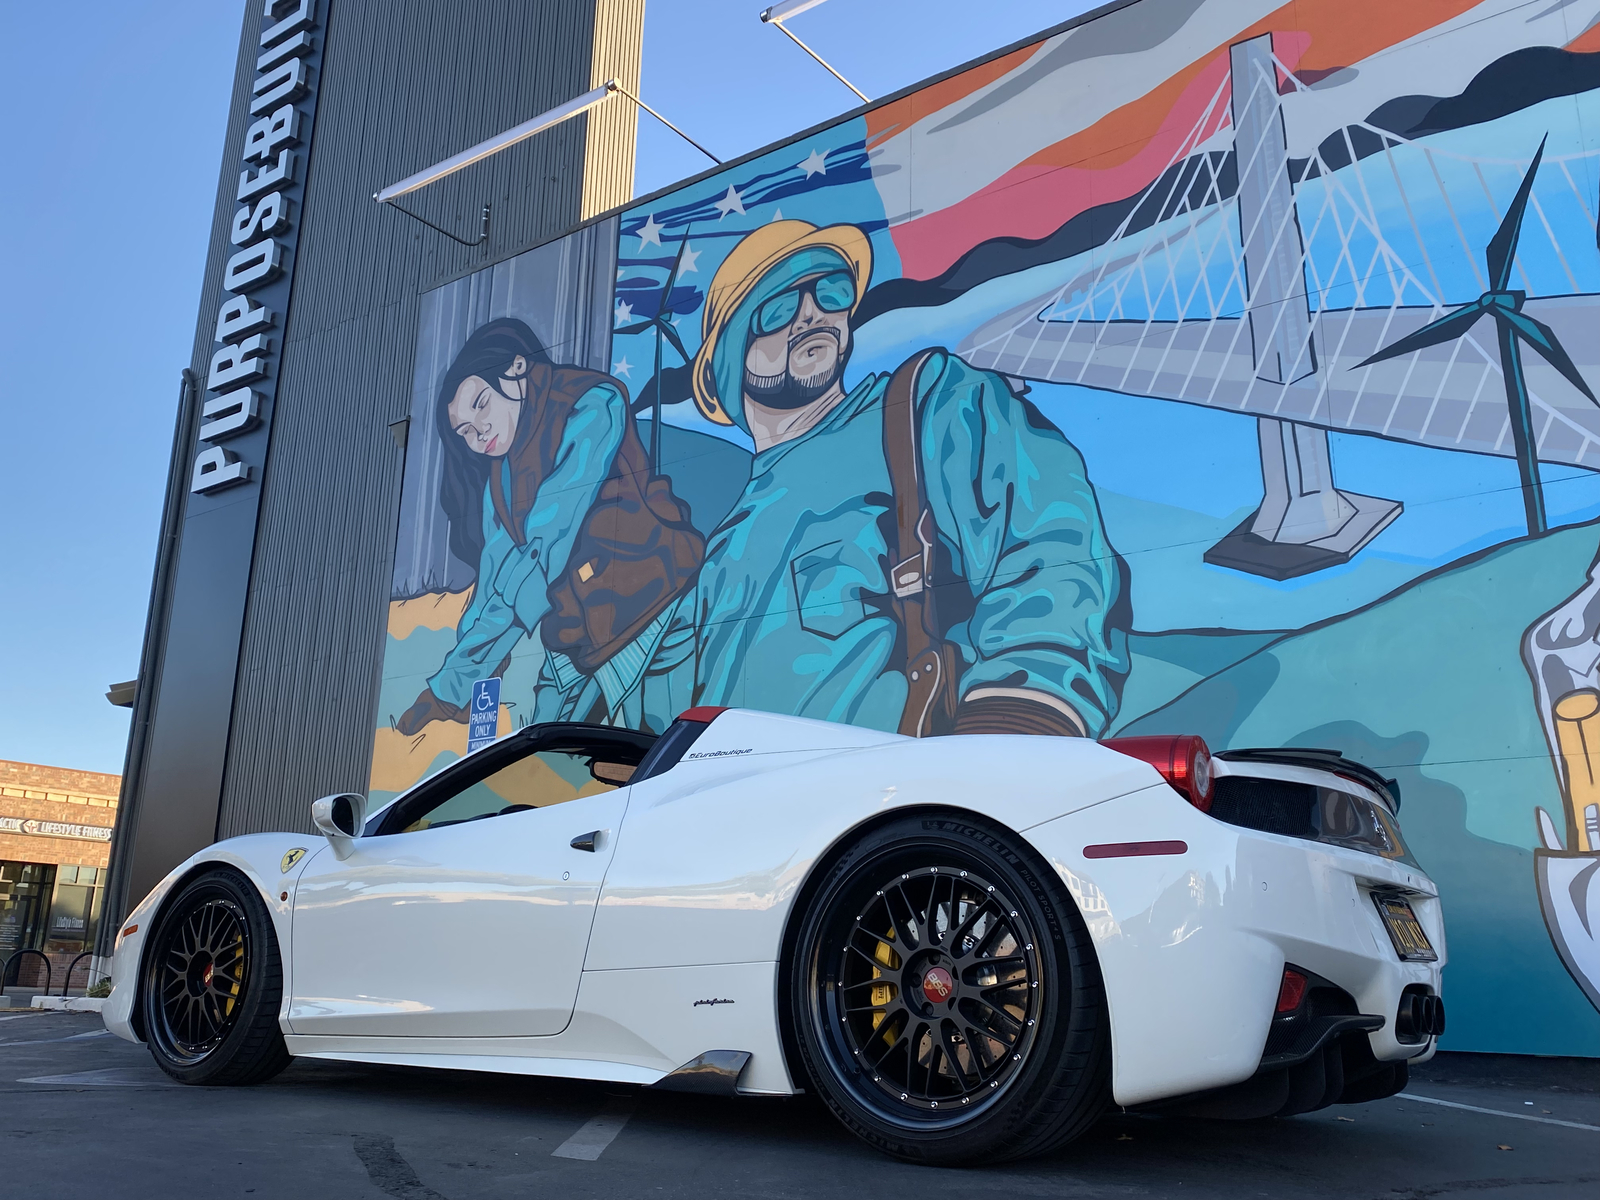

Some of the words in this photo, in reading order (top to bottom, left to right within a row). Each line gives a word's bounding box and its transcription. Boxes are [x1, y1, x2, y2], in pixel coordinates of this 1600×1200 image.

[471, 710, 497, 725] PARKING
[474, 724, 491, 737] ONLY
[40, 821, 81, 836] LIFESTYLE
[82, 826, 112, 839] FITNESS
[942, 821, 1019, 866] MICHELIN
[1020, 866, 1041, 895] PILOT
[927, 972, 949, 997] BBS
